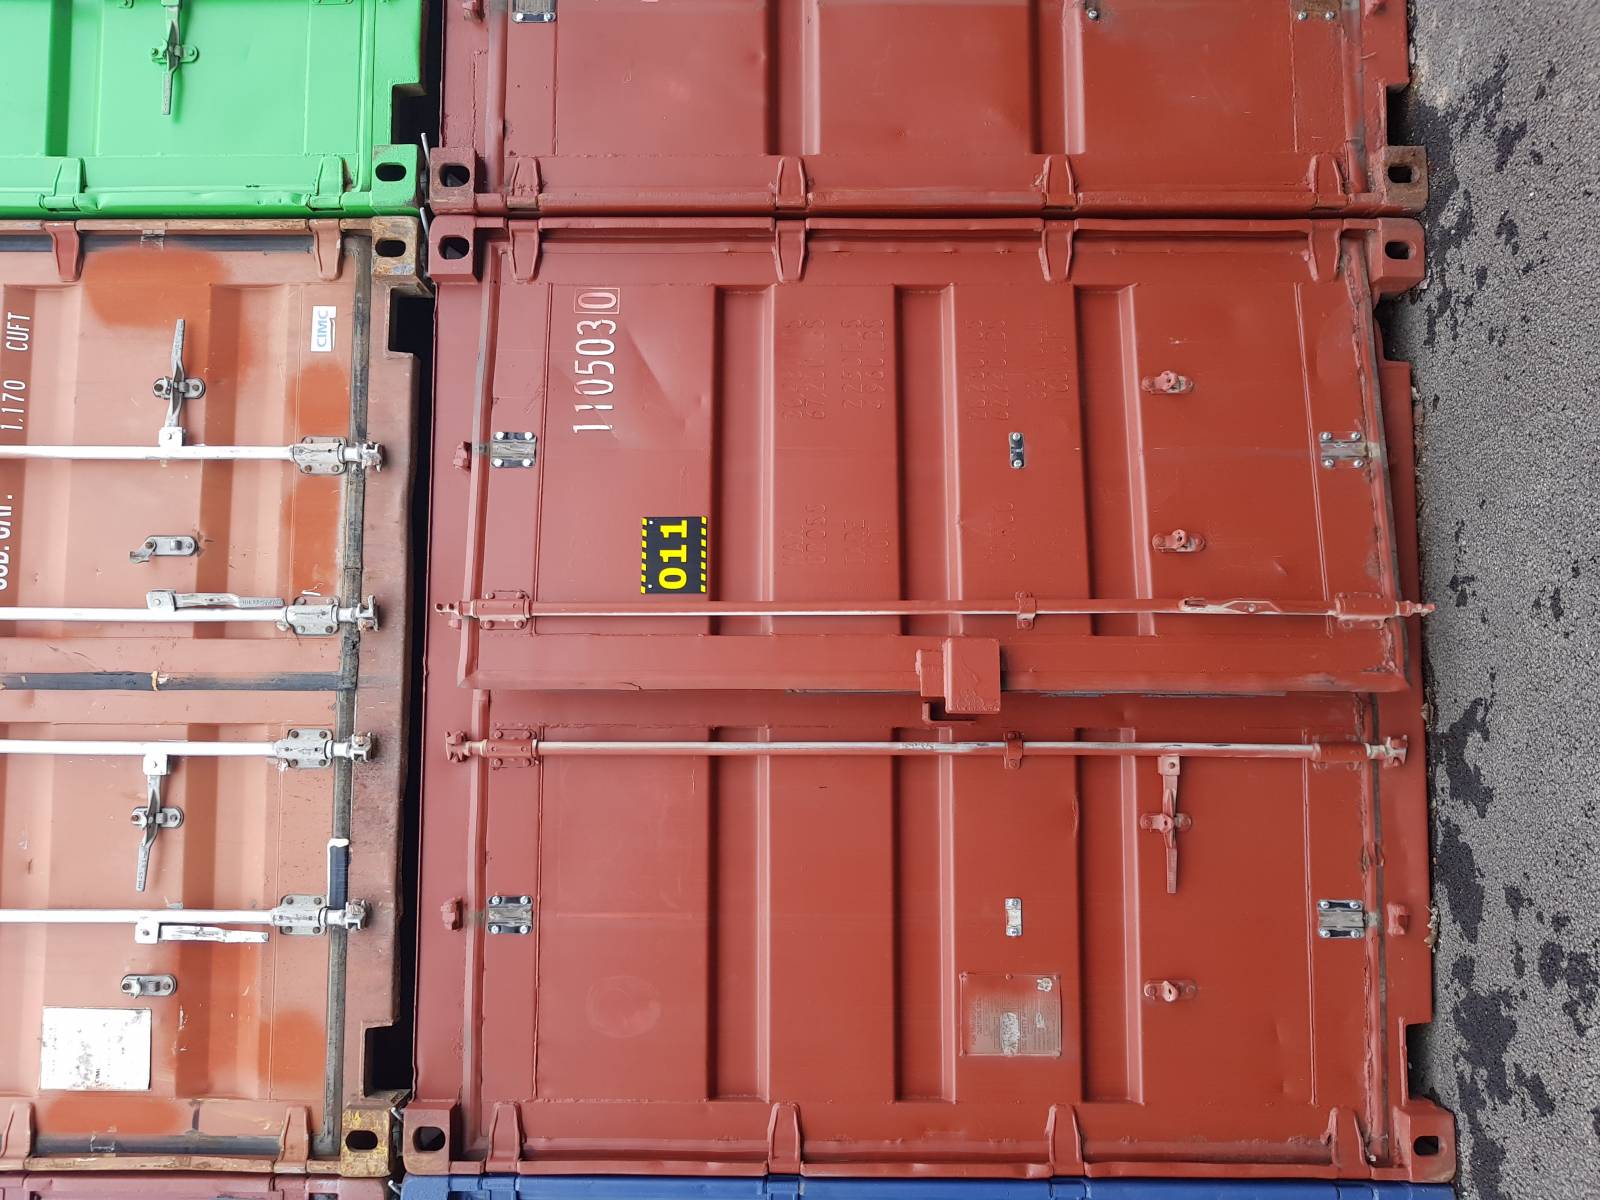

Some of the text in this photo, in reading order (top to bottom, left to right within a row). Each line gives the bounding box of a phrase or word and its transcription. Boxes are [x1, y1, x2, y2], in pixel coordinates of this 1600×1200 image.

[315, 310, 329, 348] CIMC
[0, 311, 31, 431] 1,170 CUFT
[658, 519, 688, 590] 011
